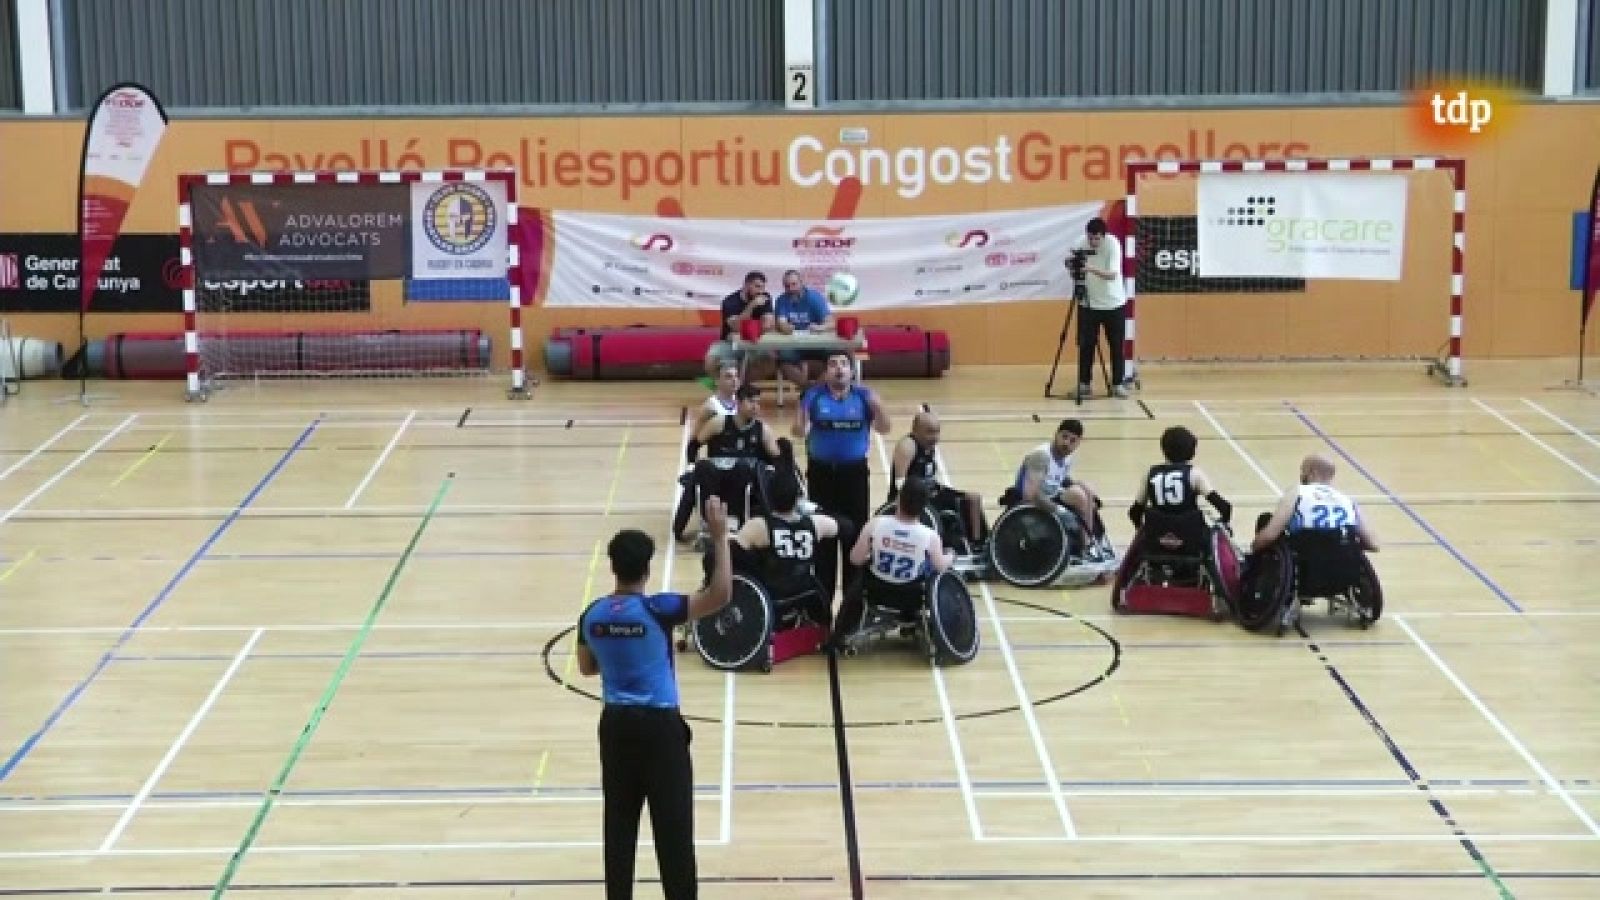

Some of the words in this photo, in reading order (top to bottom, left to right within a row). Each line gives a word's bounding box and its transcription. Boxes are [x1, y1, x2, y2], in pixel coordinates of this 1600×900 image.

[792, 71, 807, 101] 2
[788, 134, 1013, 198] Congost
[285, 214, 402, 228] ADVALOREM
[1266, 216, 1394, 254] gracare
[279, 232, 381, 246] ADVOCATS
[26, 274, 48, 289] de
[1150, 473, 1184, 506] 15
[1312, 505, 1348, 529] 22
[773, 529, 814, 560] 53
